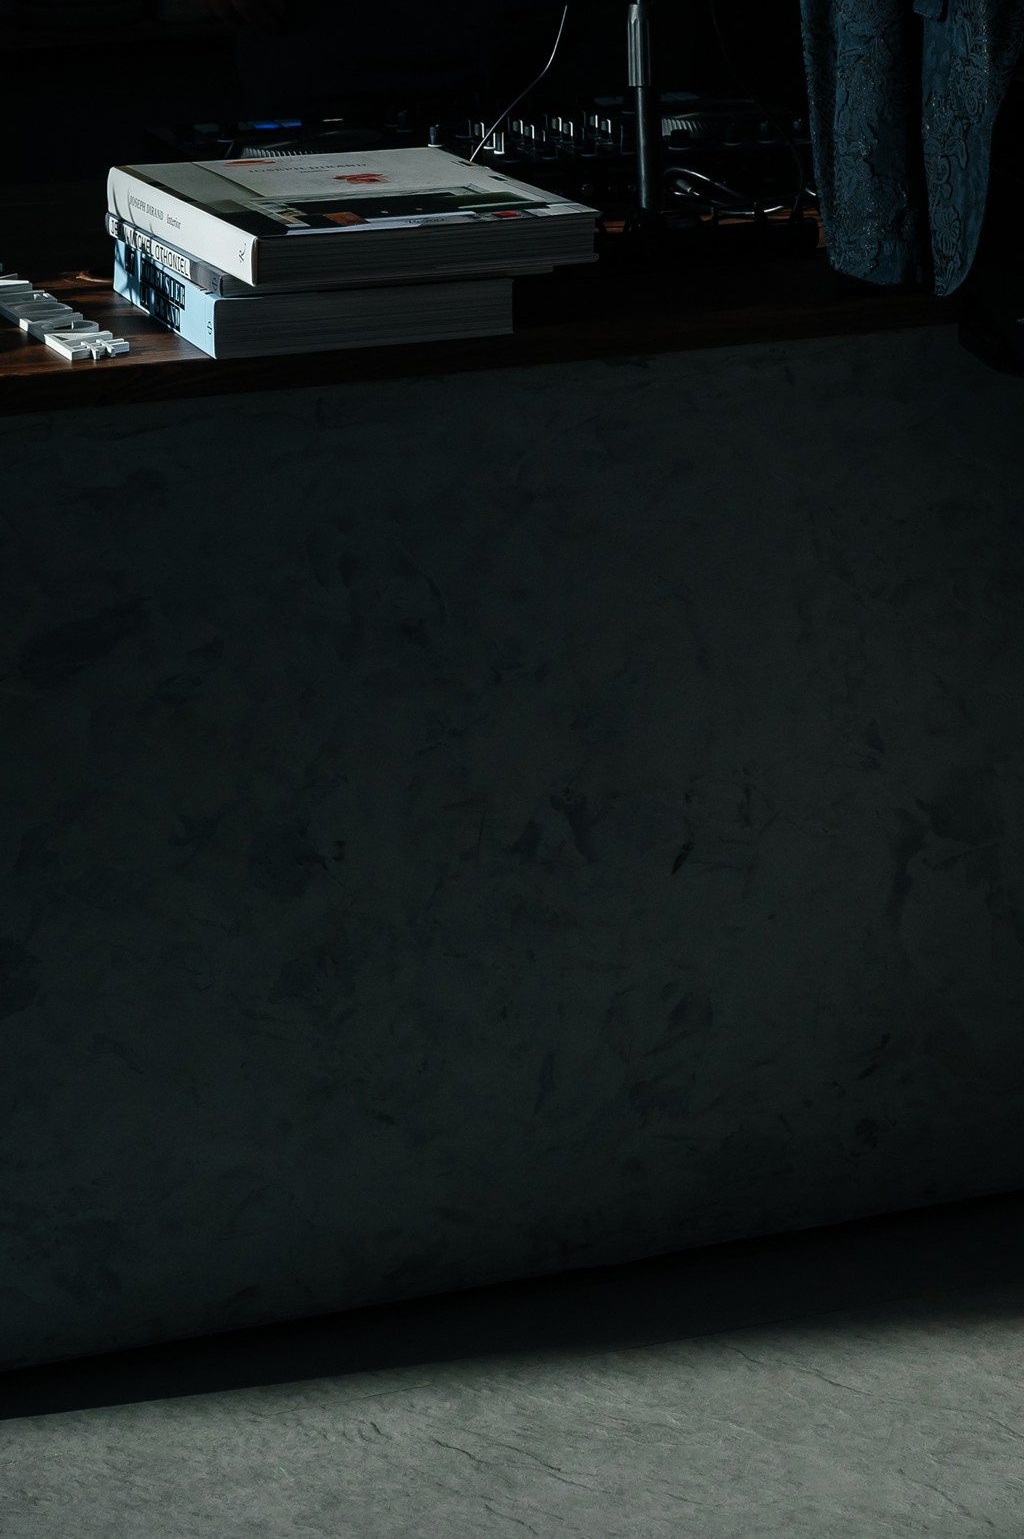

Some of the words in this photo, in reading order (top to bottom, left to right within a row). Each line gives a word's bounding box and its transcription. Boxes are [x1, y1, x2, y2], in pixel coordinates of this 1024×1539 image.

[129, 195, 146, 212] JOSEPH
[146, 203, 164, 221] DIRAND
[154, 243, 189, 276] OTHONIEL
